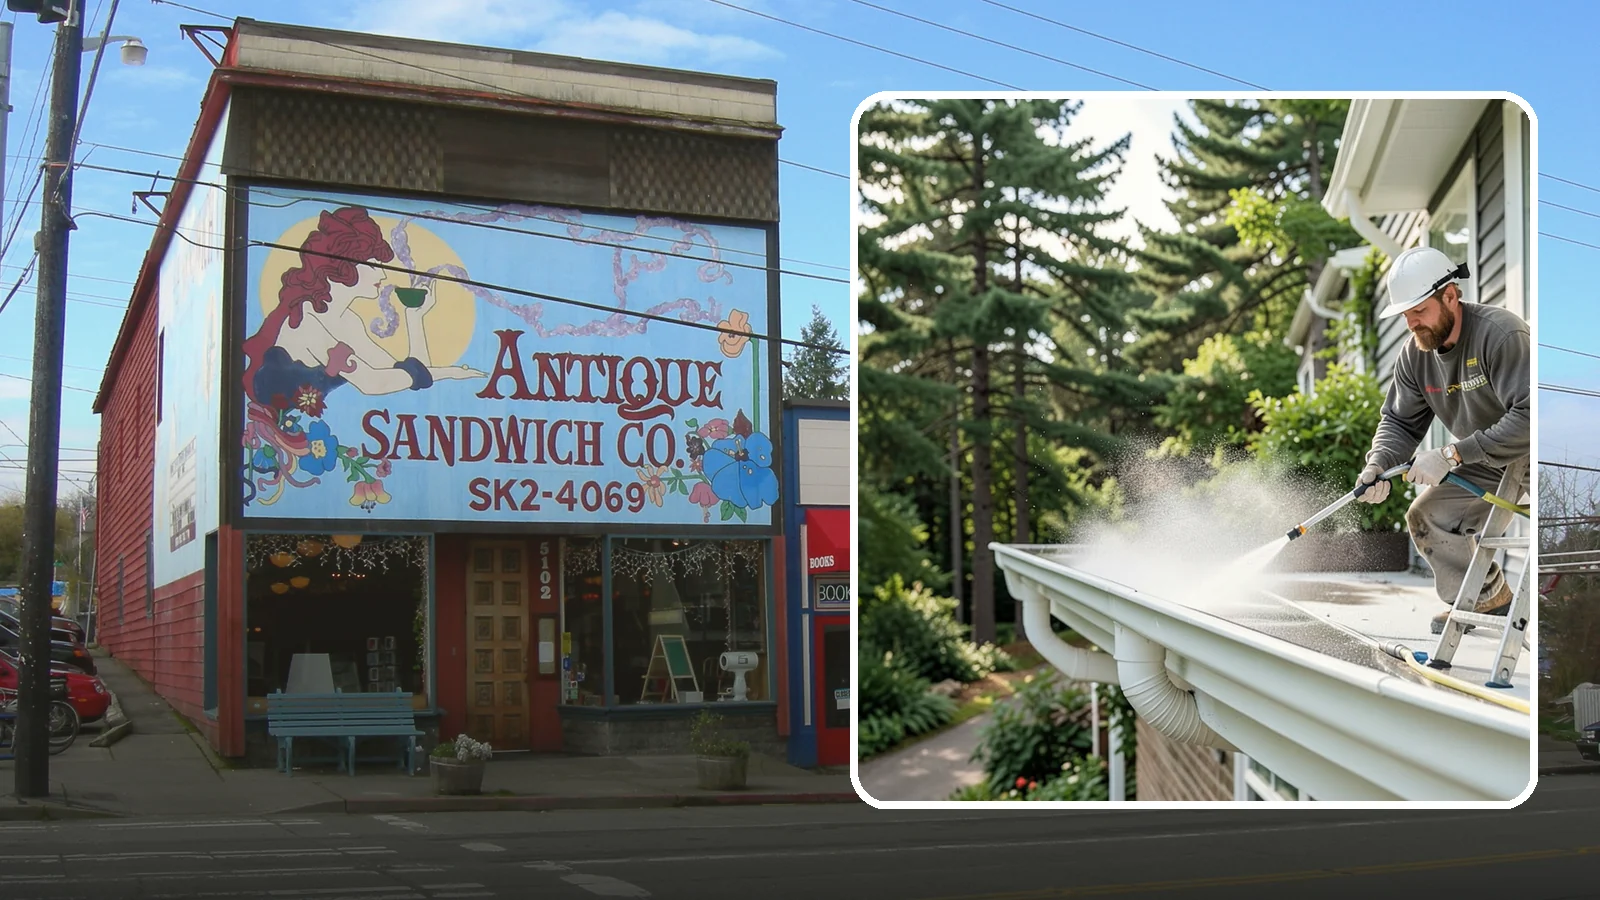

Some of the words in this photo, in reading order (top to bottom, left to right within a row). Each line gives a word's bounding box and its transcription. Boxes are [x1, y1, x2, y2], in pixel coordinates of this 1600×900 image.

[475, 328, 723, 421] ANTIQUE
[361, 409, 604, 467] SANDWICH
[618, 421, 686, 468] CO.
[468, 477, 646, 513] SK2-4069
[539, 542, 552, 600] 5102
[809, 555, 835, 569] BOOKS
